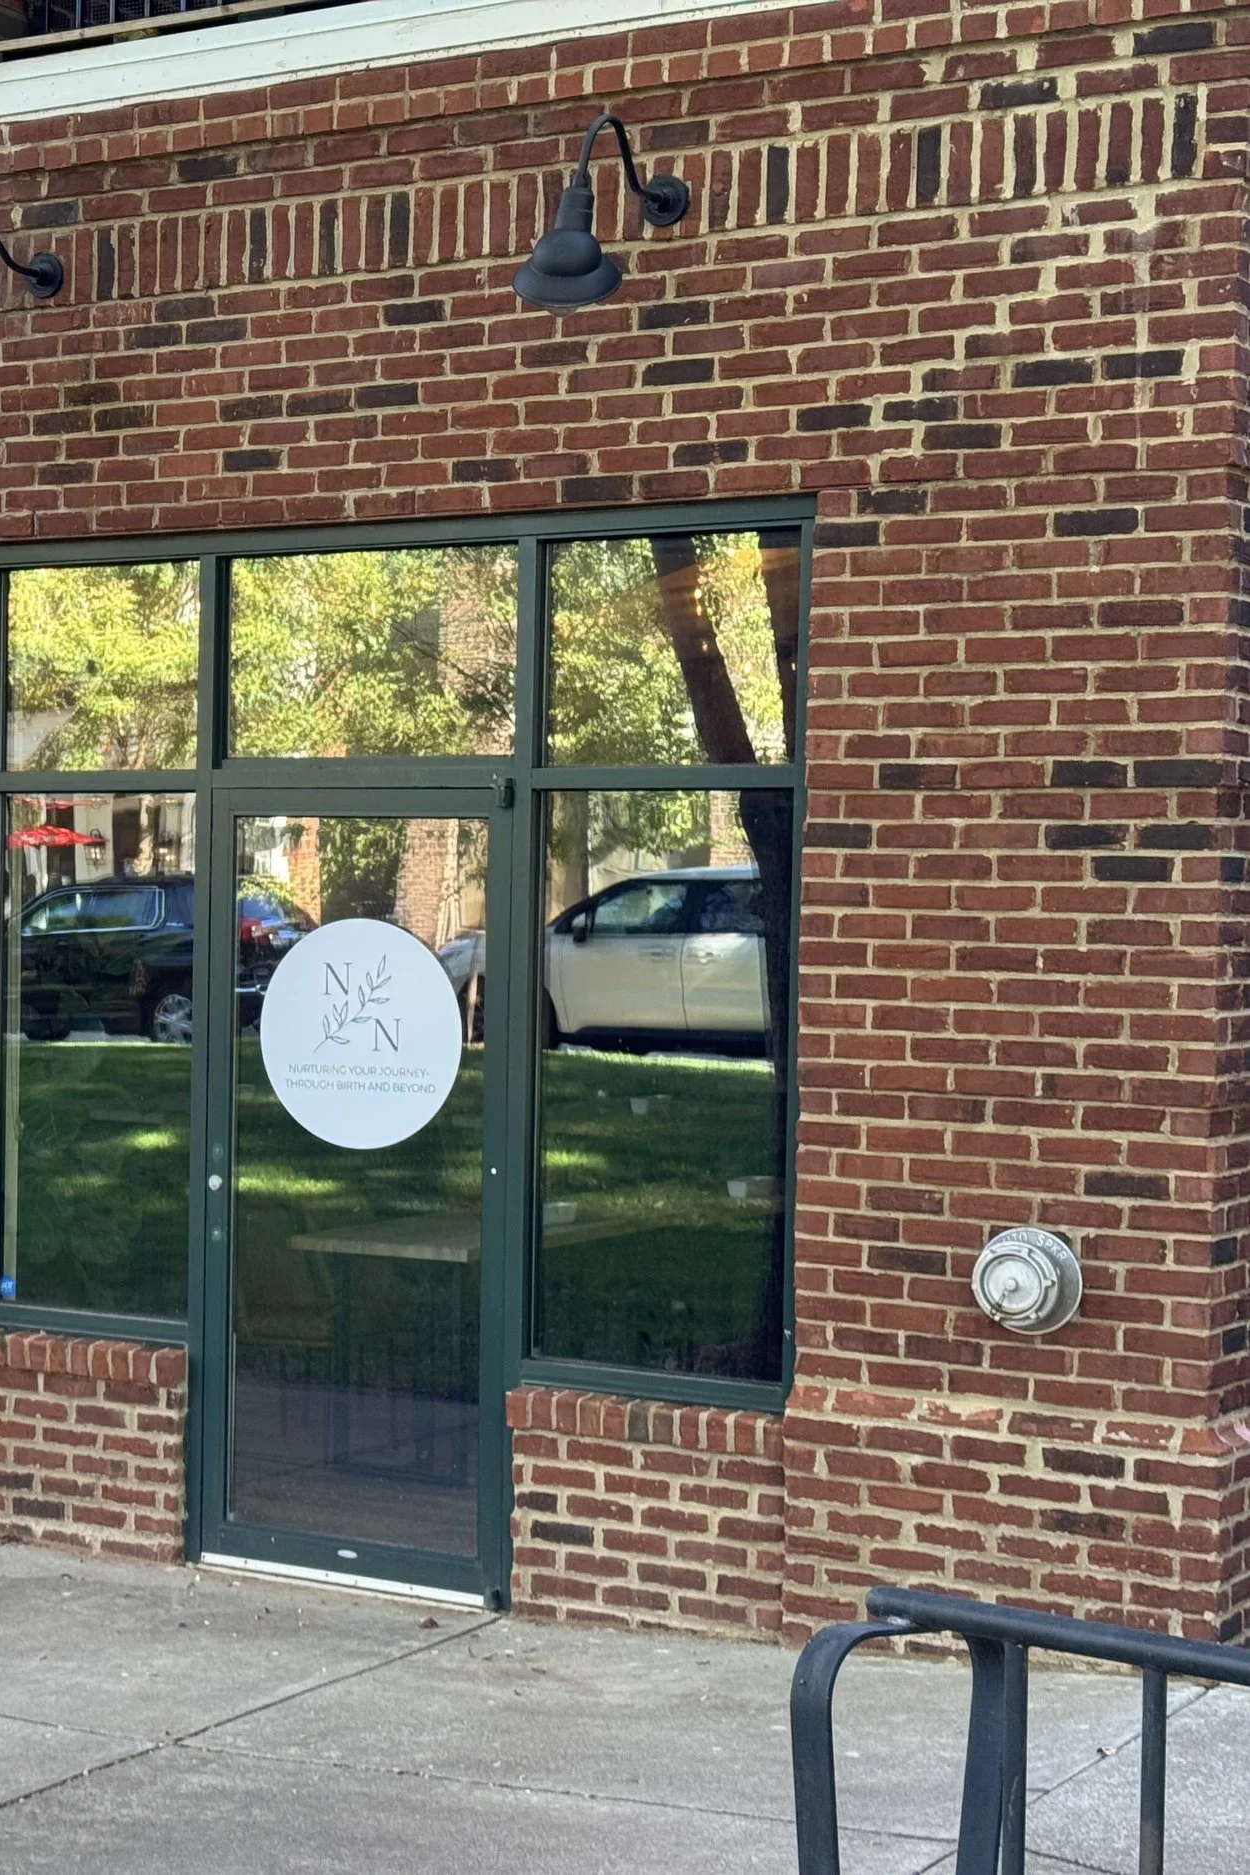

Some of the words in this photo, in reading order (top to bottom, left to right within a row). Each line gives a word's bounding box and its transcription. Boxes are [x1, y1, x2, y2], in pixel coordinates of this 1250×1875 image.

[322, 961, 352, 996] N
[372, 1017, 402, 1052] N
[288, 1063, 348, 1075] NURTURING
[349, 1065, 377, 1076] YOUR
[285, 1078, 335, 1090] THROUGH
[337, 1080, 366, 1091] BIRTH
[368, 1081, 391, 1092] AND
[393, 1082, 437, 1094] BEYOND
[1036, 1234, 1067, 1260] SPKR
